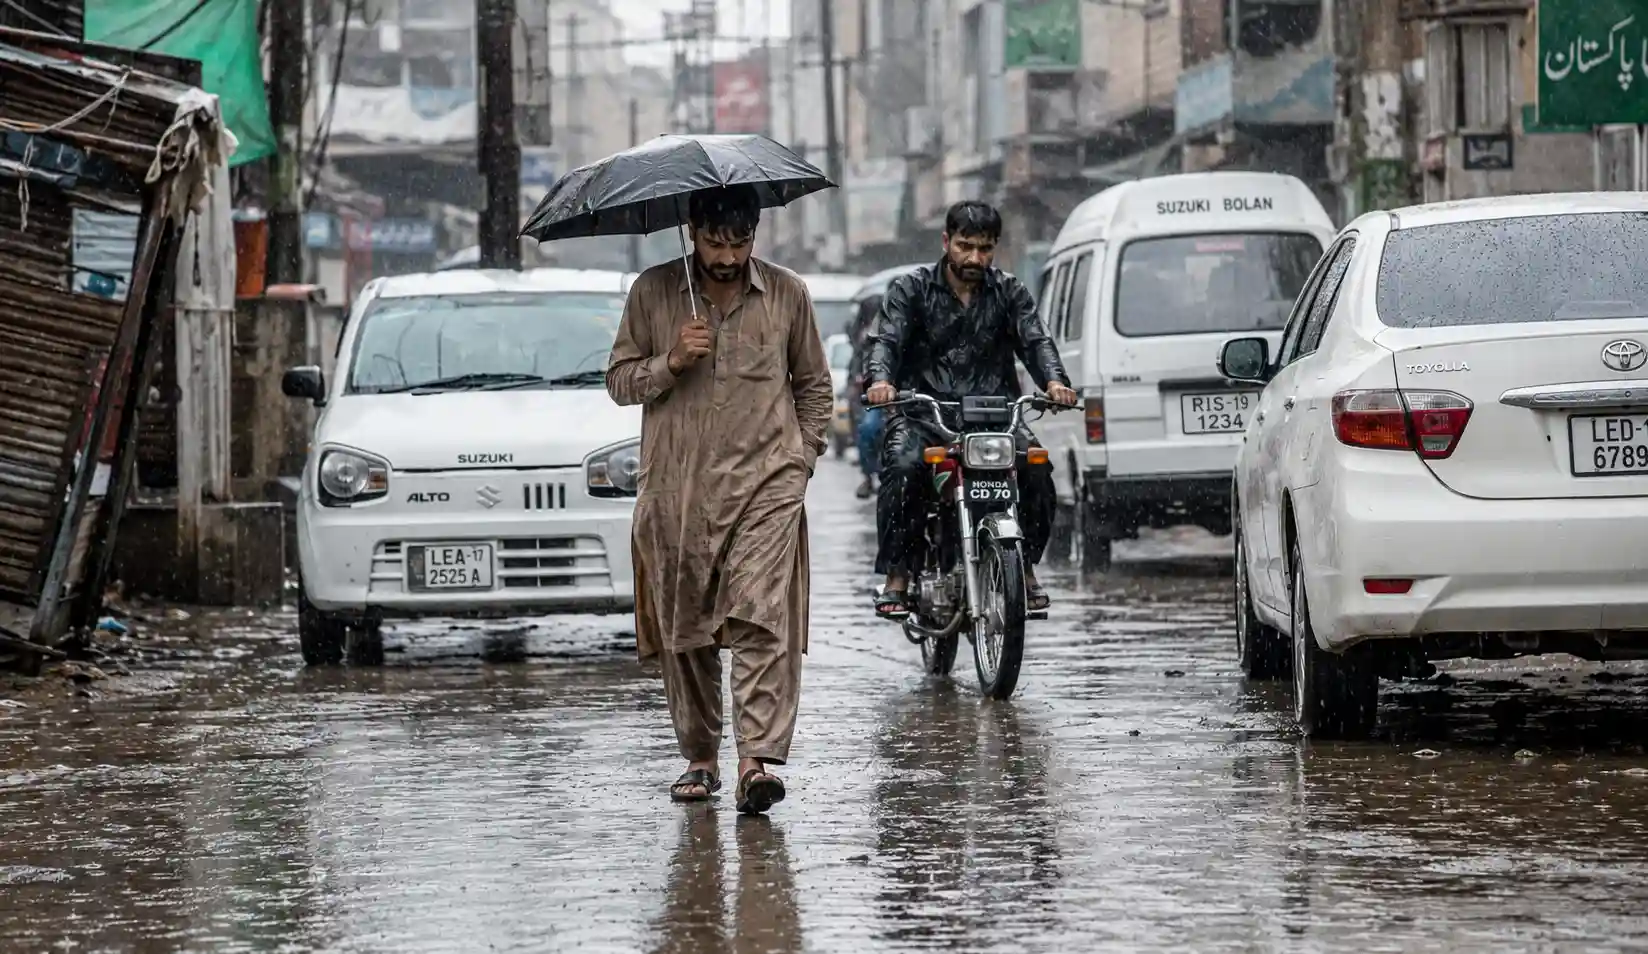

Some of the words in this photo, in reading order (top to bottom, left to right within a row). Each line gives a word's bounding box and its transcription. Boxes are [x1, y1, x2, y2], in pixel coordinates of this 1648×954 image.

[1544, 14, 1635, 92] پاکستان
[1156, 200, 1211, 215] SUZUKI
[1223, 197, 1274, 212] BOLAN
[1406, 361, 1471, 375] TOYOLLA
[1192, 395, 1249, 412] RIS-19
[1198, 413, 1243, 430] 1234
[457, 453, 513, 464] SUZUKI
[1593, 445, 1648, 469] 6789
[972, 481, 1009, 489] HONDA
[406, 492, 450, 503] ALTO
[969, 489, 990, 499] CD
[993, 489, 1011, 499] 70
[429, 568, 467, 585] 2525
[471, 568, 481, 583] A
